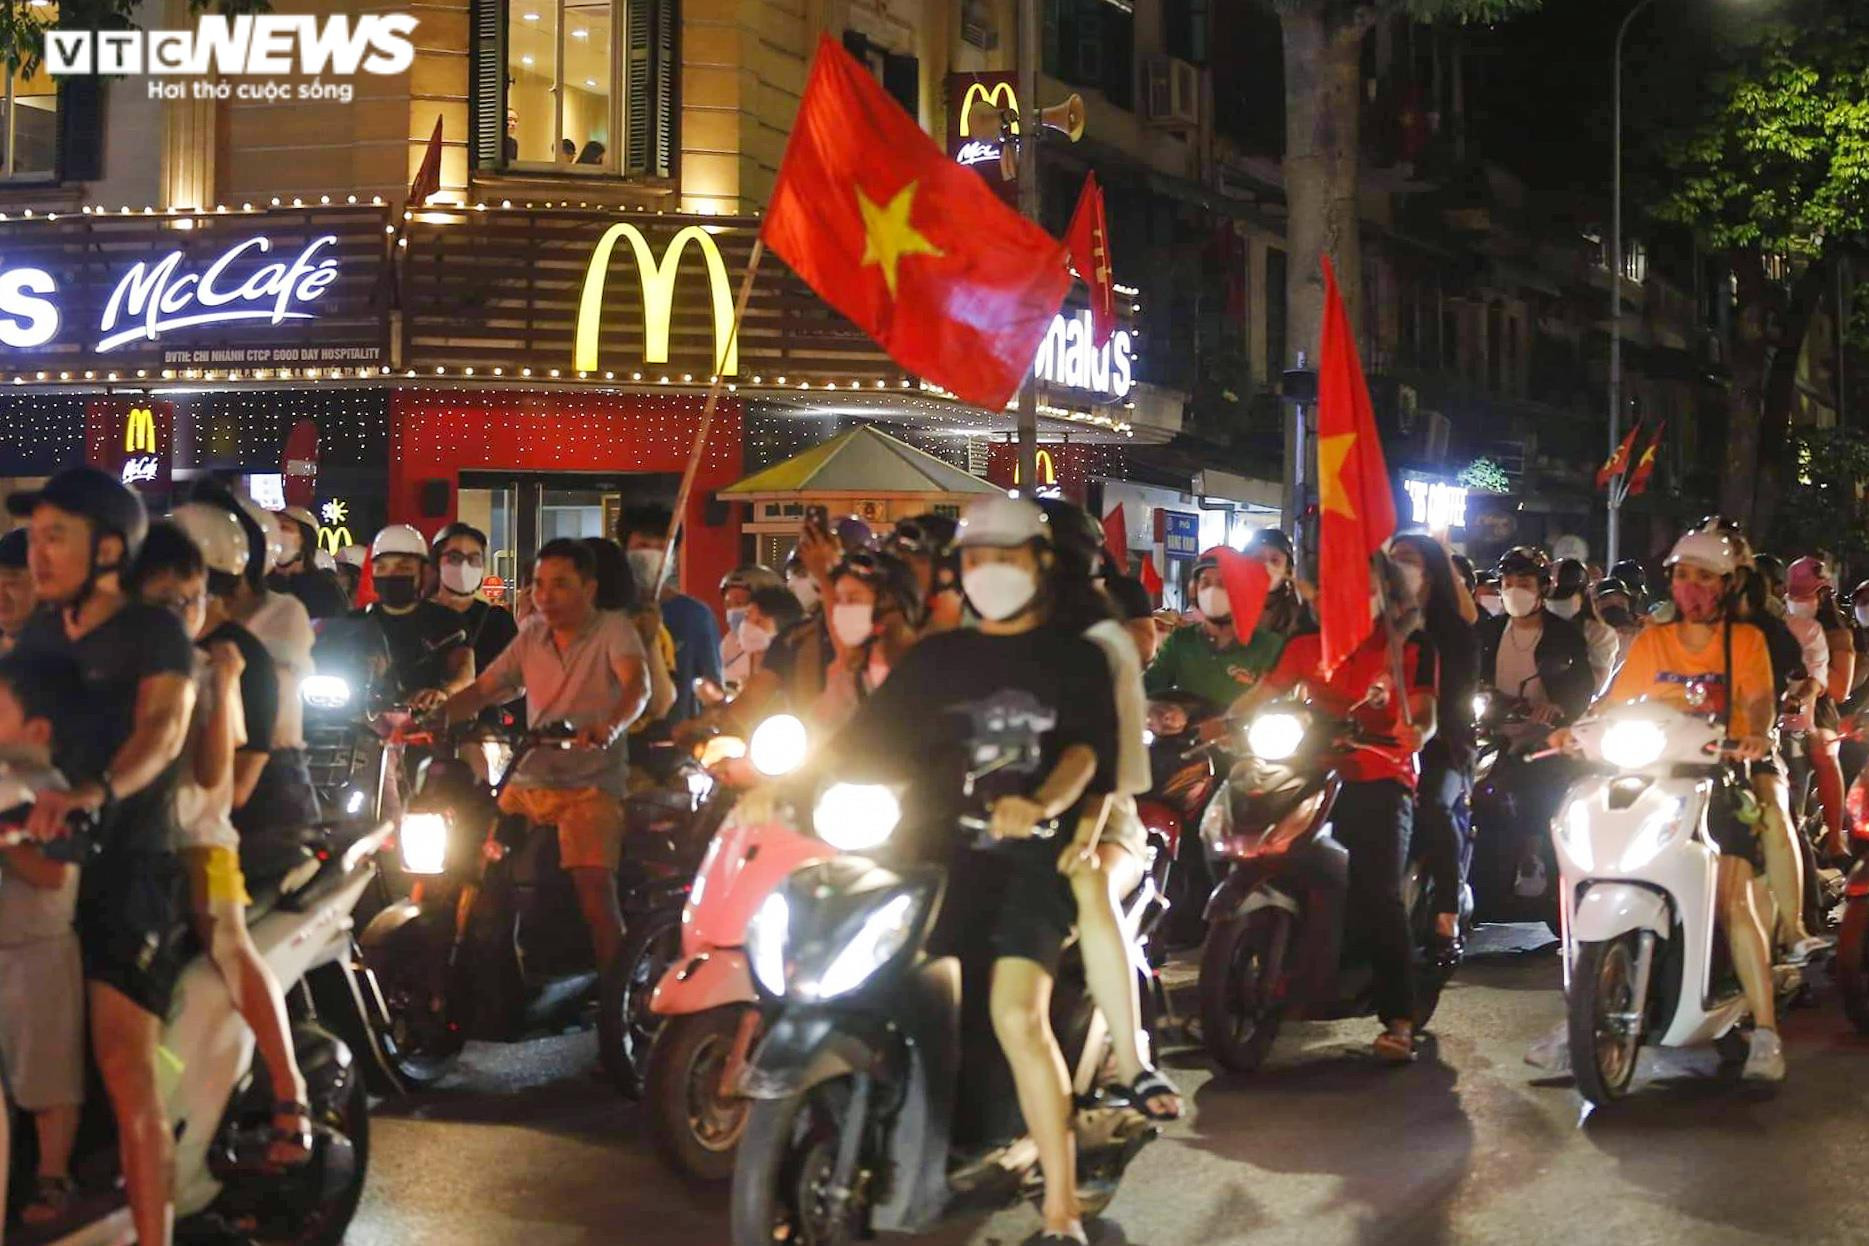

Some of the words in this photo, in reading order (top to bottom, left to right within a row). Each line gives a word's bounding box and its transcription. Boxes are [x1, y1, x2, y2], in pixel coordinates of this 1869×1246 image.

[99, 235, 338, 342] McCafé
[246, 349, 271, 361] CTCP
[273, 349, 299, 361] GOOD
[301, 348, 319, 361] DAY
[321, 347, 380, 360] HOSPITALITY
